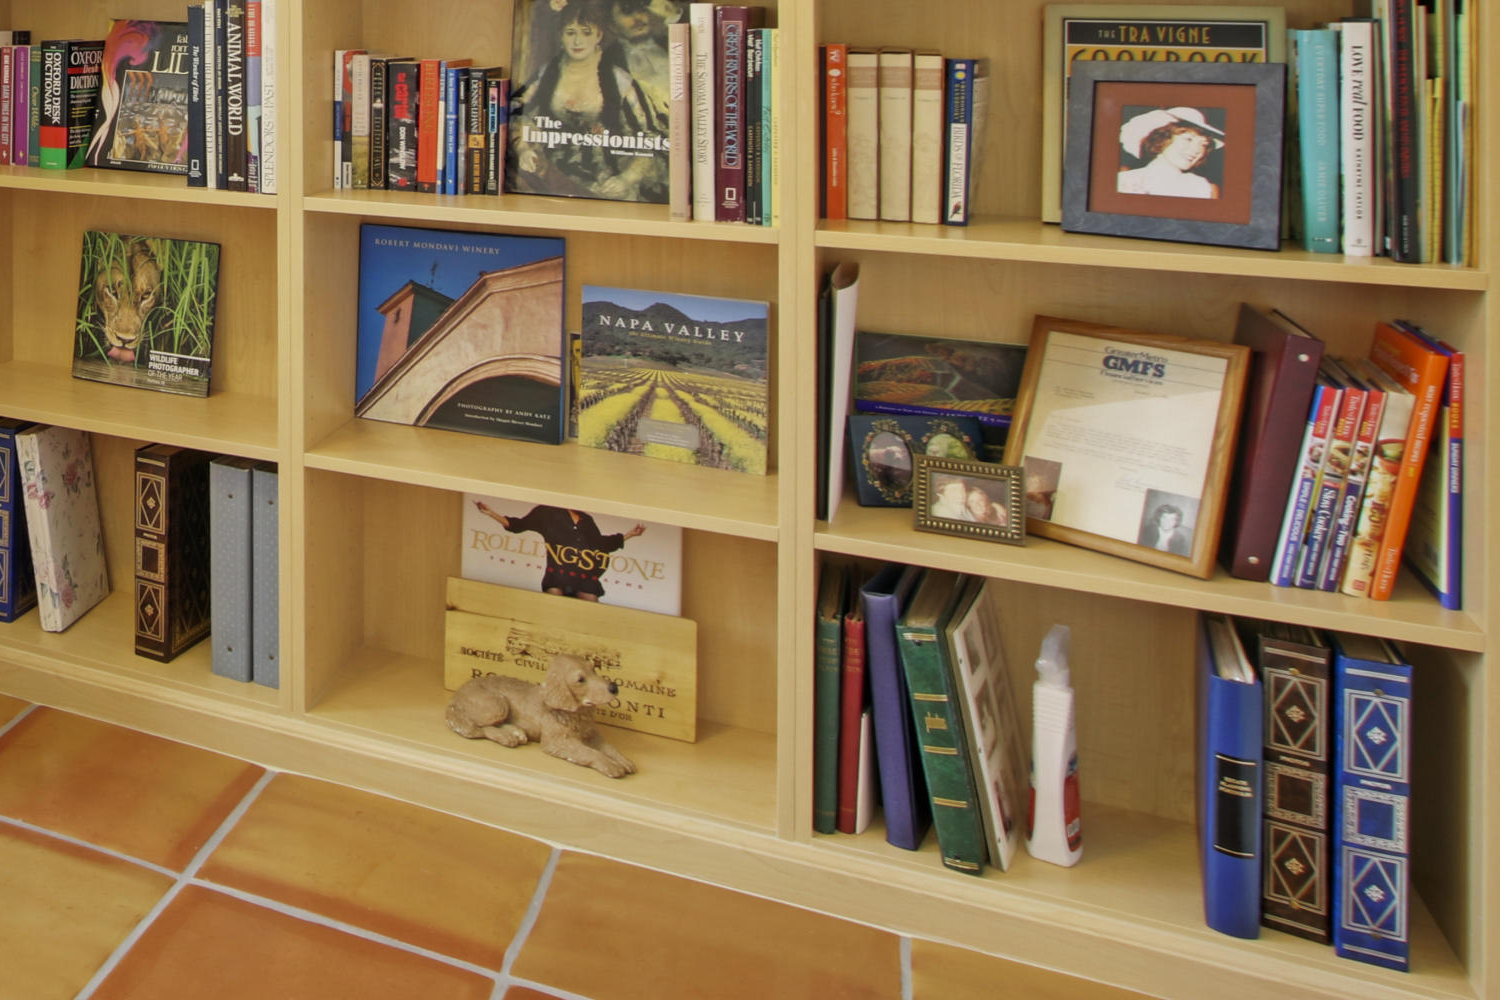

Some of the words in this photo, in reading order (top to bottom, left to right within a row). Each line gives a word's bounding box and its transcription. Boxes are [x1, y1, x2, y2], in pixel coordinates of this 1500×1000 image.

[725, 24, 739, 58] GREAT
[1118, 26, 1150, 43] TRA
[1156, 26, 1212, 44] VIGNE
[70, 51, 103, 65] OXFOR
[227, 22, 242, 81] ANIMAL
[1350, 45, 1364, 78] LOVE
[44, 53, 54, 117] DICTIONARY
[52, 52, 62, 95] OXFORD
[725, 59, 739, 95] RIVERS
[425, 63, 436, 133] BIRDSONG
[697, 72, 708, 106] SONOMA
[725, 95, 738, 109] OF
[1352, 79, 1368, 106] real
[52, 97, 61, 124] DESK
[228, 82, 243, 135] WORLD
[725, 112, 739, 128] THE
[533, 116, 562, 129] The
[697, 108, 708, 137] VALLEY
[1352, 107, 1364, 141] FOOD
[522, 125, 670, 152] Impressionists
[697, 139, 709, 165] STORY
[725, 128, 739, 166] WORLD
[953, 126, 965, 152] BIRDS
[952, 162, 964, 199] FLORIDA
[374, 238, 410, 248] ROBERT
[413, 241, 459, 252] MONDAVI
[462, 245, 500, 255] WINERY
[599, 315, 653, 332] NAPA
[664, 322, 745, 343] VALLEY
[148, 362, 199, 376] PHOTOGRAPHER
[150, 354, 178, 364] WILDLIFE
[1103, 355, 1164, 377] GMFS
[1415, 403, 1433, 440] requested
[1451, 442, 1460, 468] SUNDAY
[1451, 467, 1460, 494] DINNERS
[1322, 488, 1335, 509] Slow
[1339, 495, 1355, 525] Cooking
[1312, 509, 1330, 543] Cooker
